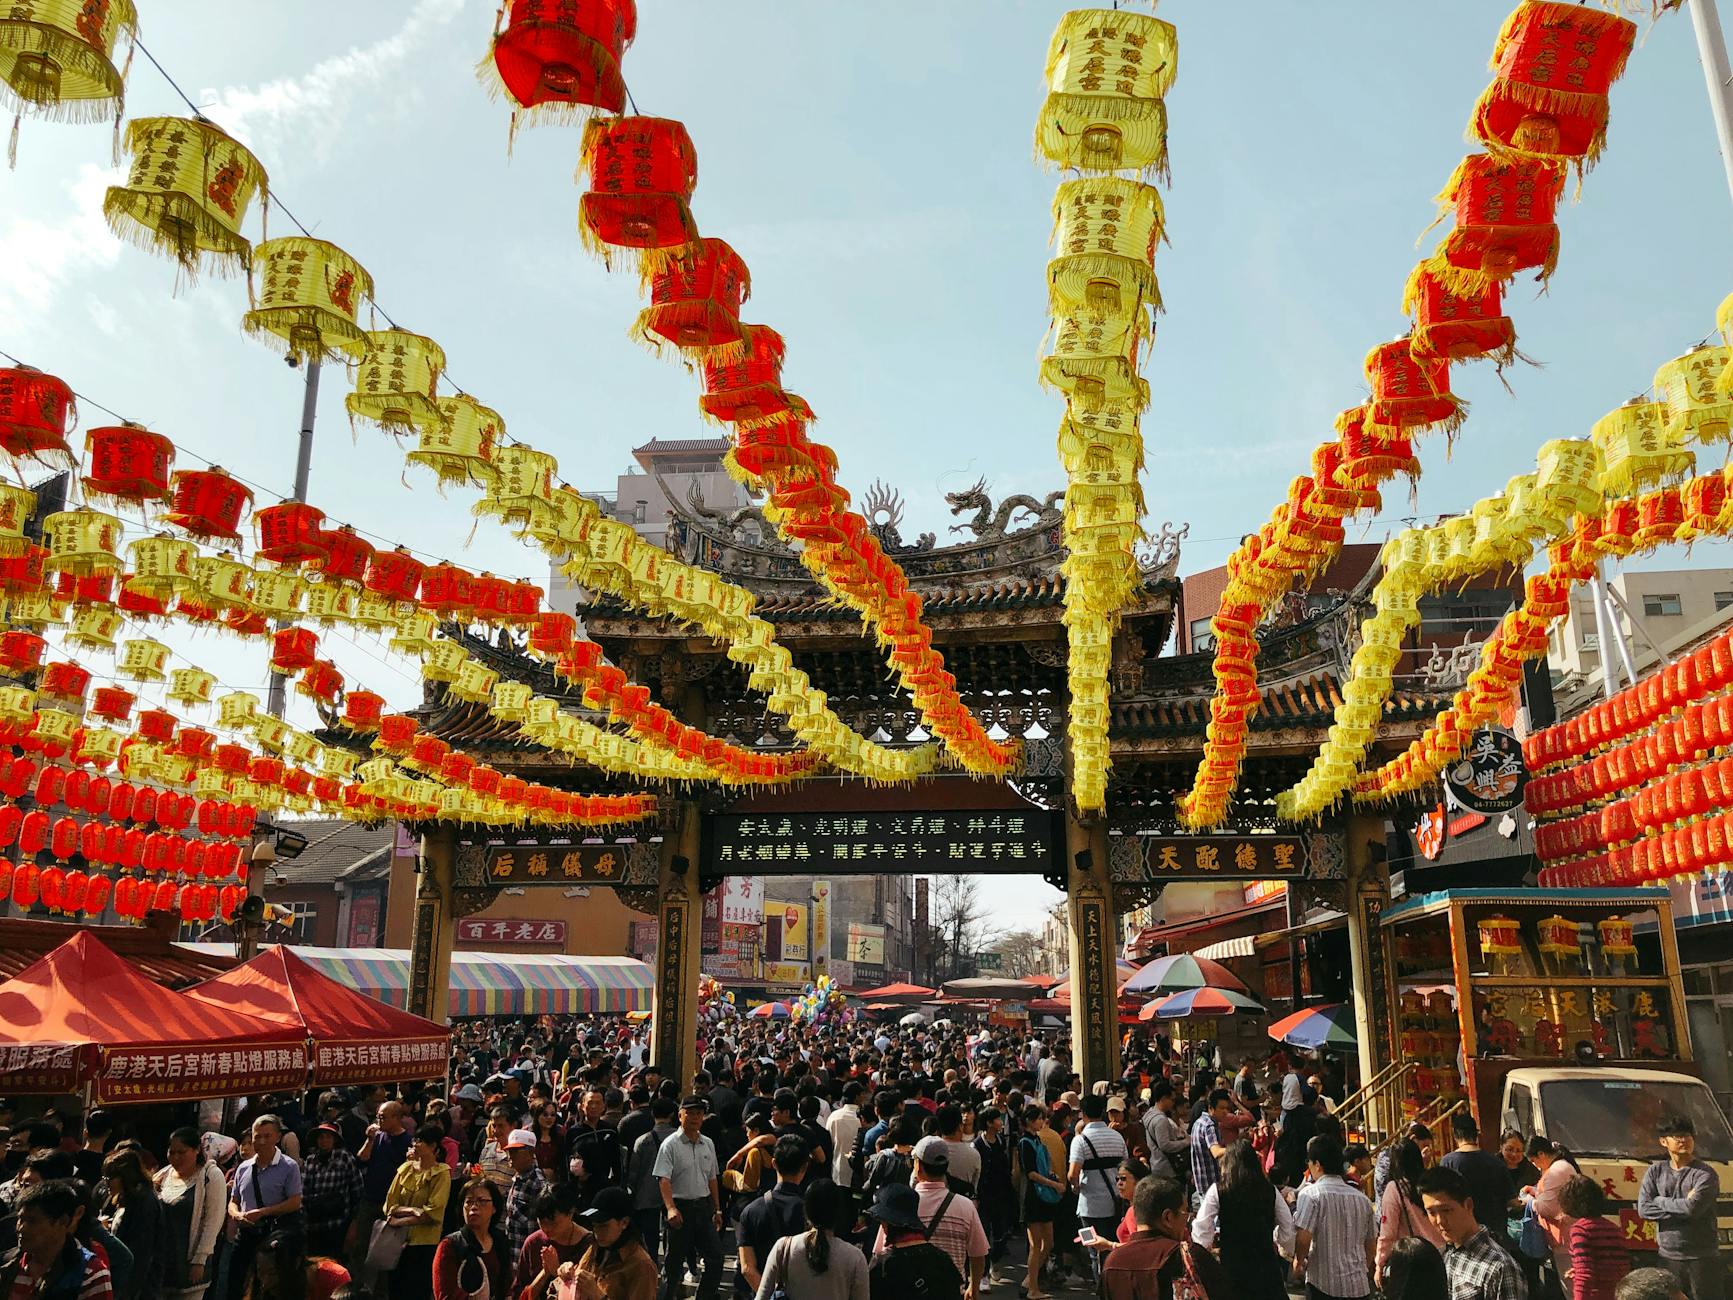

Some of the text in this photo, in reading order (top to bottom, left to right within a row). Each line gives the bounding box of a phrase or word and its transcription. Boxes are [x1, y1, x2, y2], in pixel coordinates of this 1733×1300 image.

[467, 922, 557, 940] 百年老店
[103, 1049, 304, 1080] 鹿港天后宮新春點燈服務處
